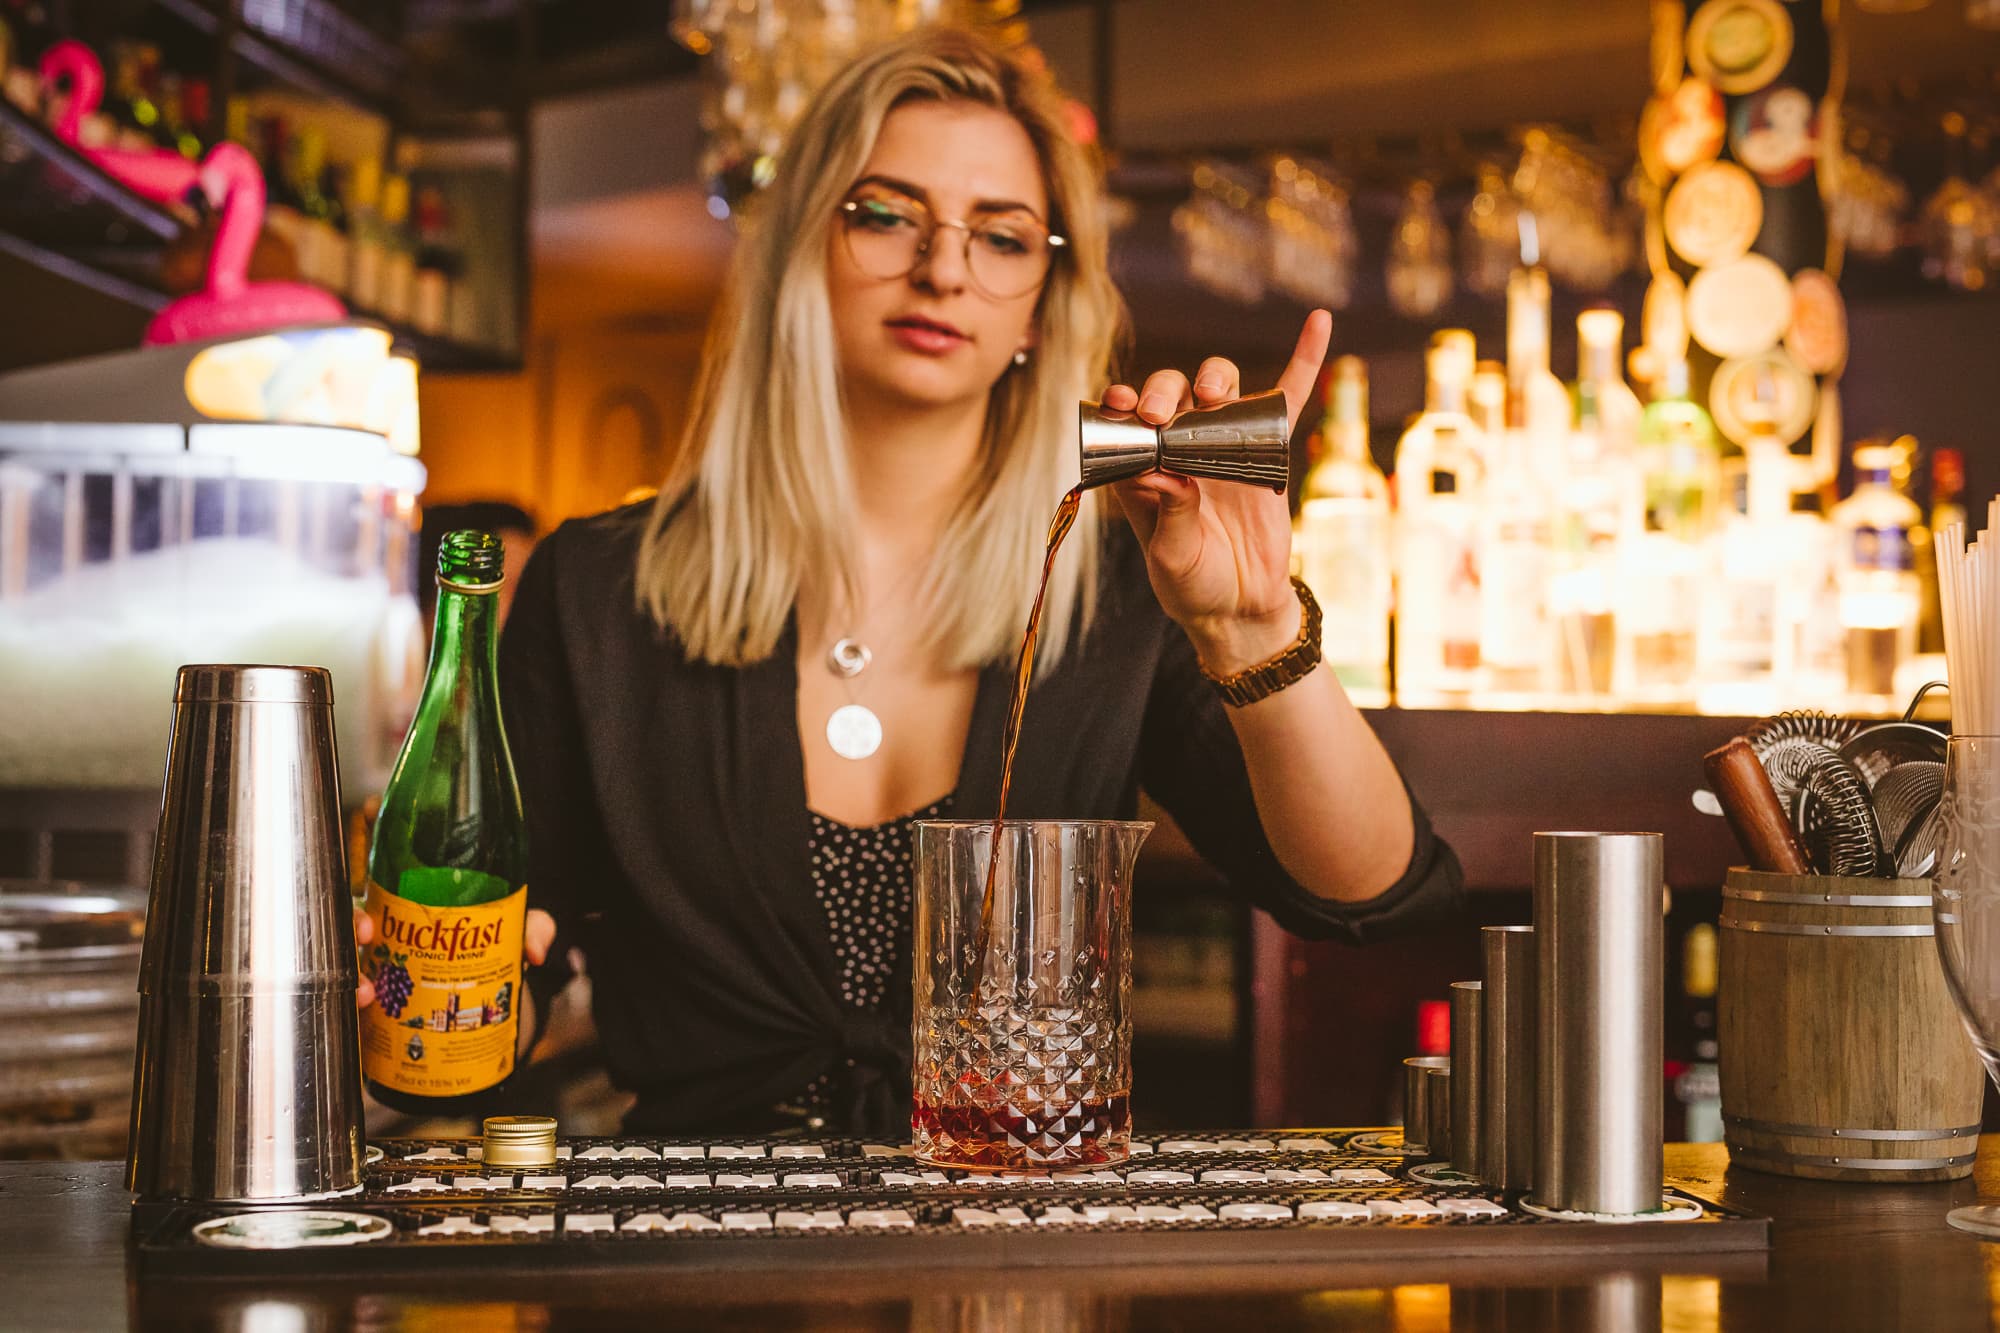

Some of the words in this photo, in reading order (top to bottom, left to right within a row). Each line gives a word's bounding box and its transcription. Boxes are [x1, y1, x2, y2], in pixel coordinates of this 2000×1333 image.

[382, 905, 503, 961] buckfast
[409, 949, 446, 960] TONIC
[456, 951, 486, 960] WINE
